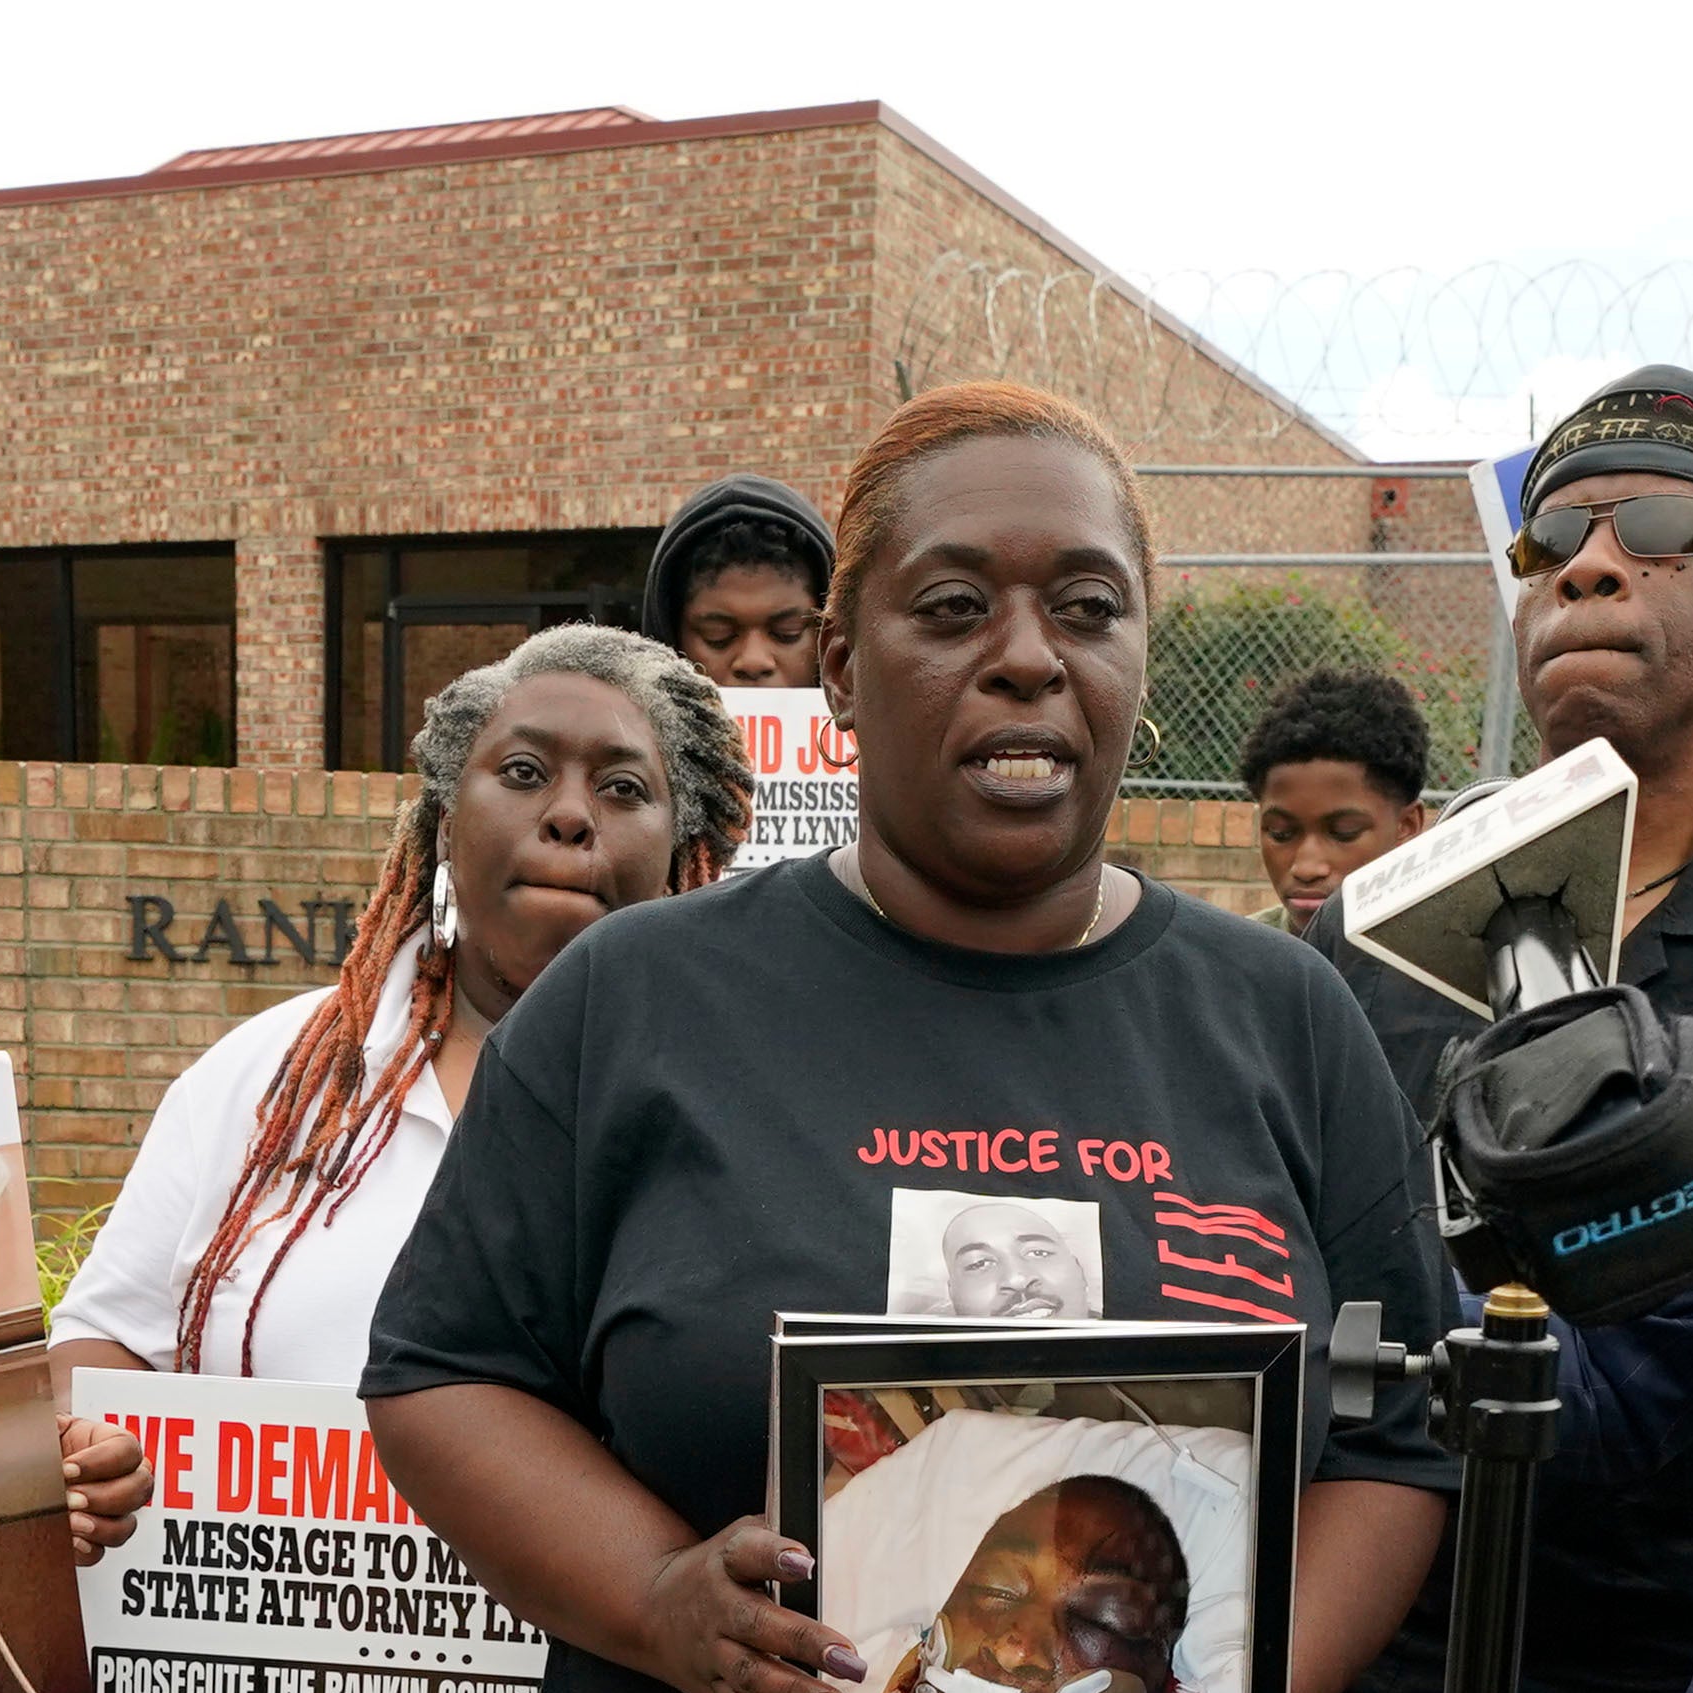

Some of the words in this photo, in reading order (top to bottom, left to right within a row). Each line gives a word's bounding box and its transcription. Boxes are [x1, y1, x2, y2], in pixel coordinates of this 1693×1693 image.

[746, 816, 787, 845] EY
[857, 1127, 1060, 1173] JUSTICE
[1076, 1138, 1174, 1184] FOR
[216, 1421, 426, 1527] DEMA
[163, 1518, 356, 1578] MESSAGE
[364, 1533, 418, 1582] TO
[425, 1537, 478, 1587] M
[121, 1569, 249, 1622] STATE
[256, 1578, 477, 1639] ATTORNEY
